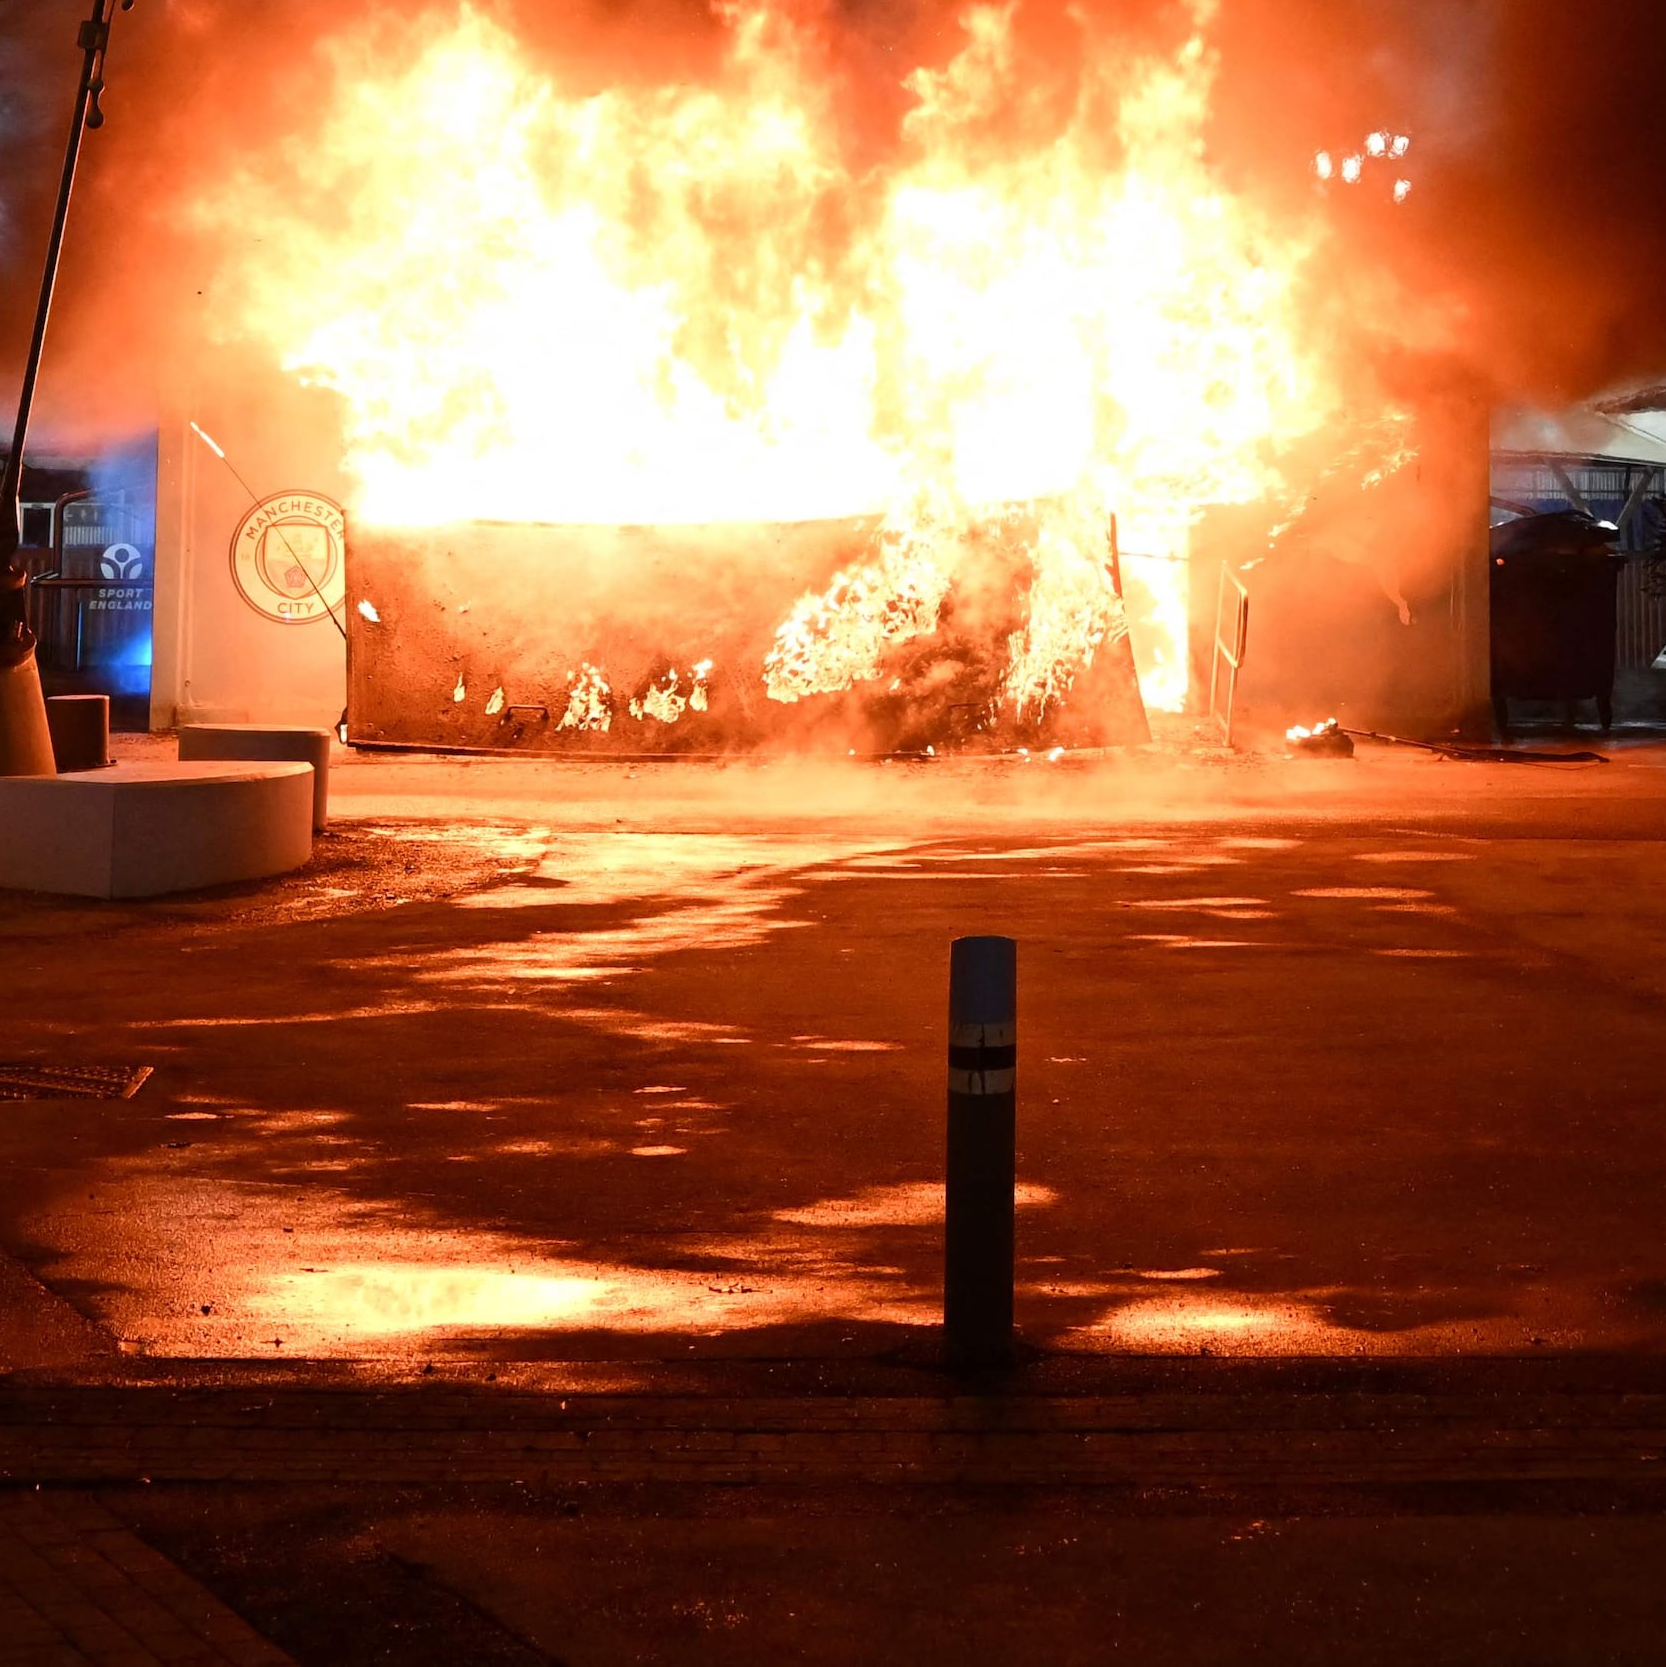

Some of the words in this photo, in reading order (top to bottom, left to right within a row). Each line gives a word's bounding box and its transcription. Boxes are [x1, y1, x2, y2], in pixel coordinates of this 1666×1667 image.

[98, 588, 143, 598] SPORT
[89, 600, 152, 610] ENGLAND
[277, 602, 314, 614] CITY
